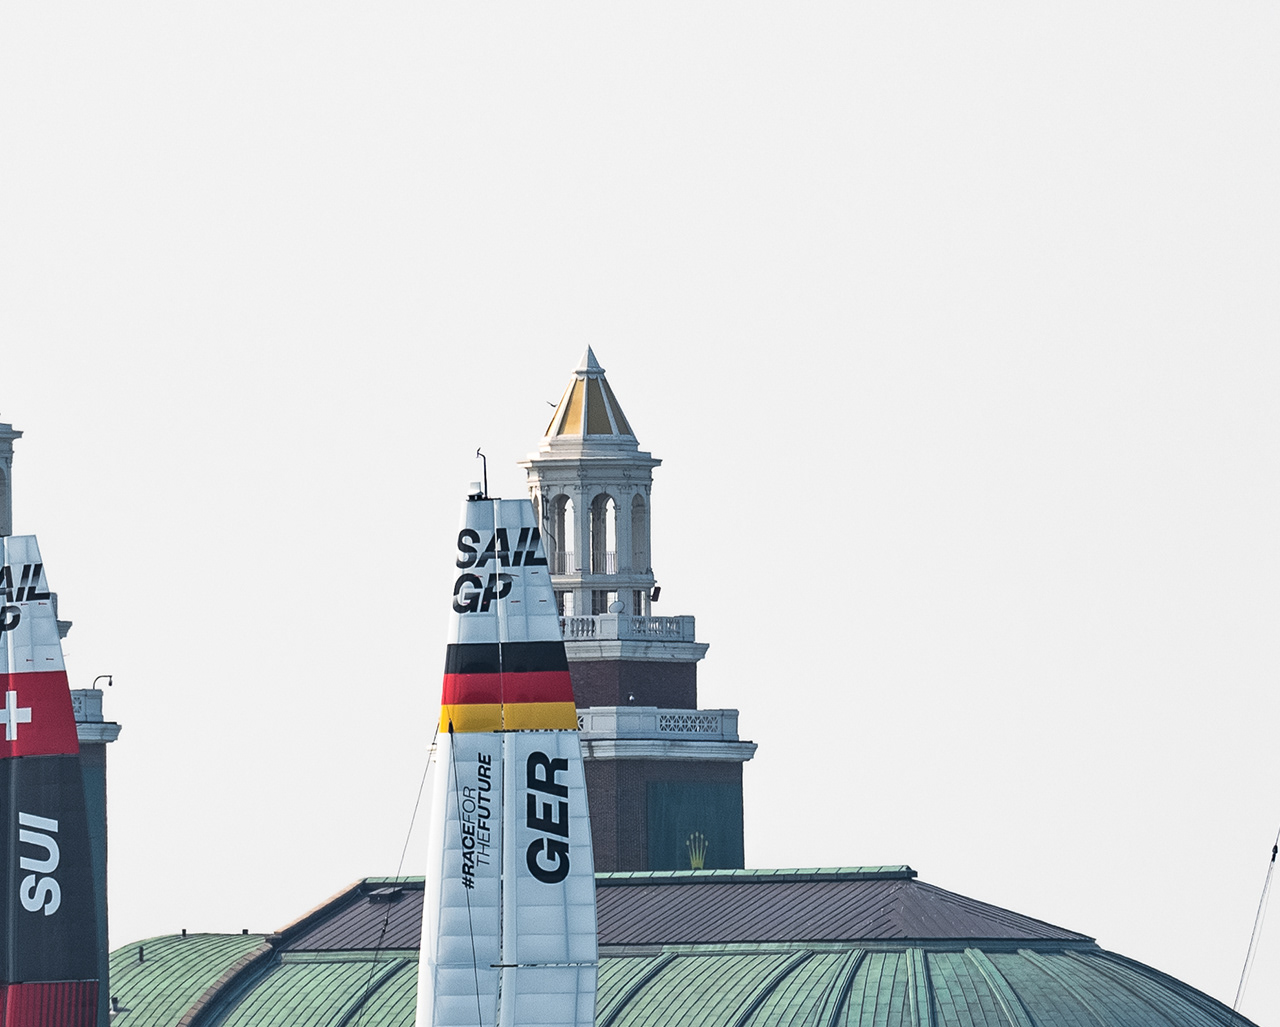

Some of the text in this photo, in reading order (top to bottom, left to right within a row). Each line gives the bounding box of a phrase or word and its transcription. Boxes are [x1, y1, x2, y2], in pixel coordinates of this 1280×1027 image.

[452, 573, 512, 614] GP
[456, 526, 547, 569] SAIL
[462, 785, 476, 890] #RACEFOR
[476, 752, 492, 867] THEFUTURE
[526, 751, 569, 885] GER
[19, 812, 62, 916] SUI
